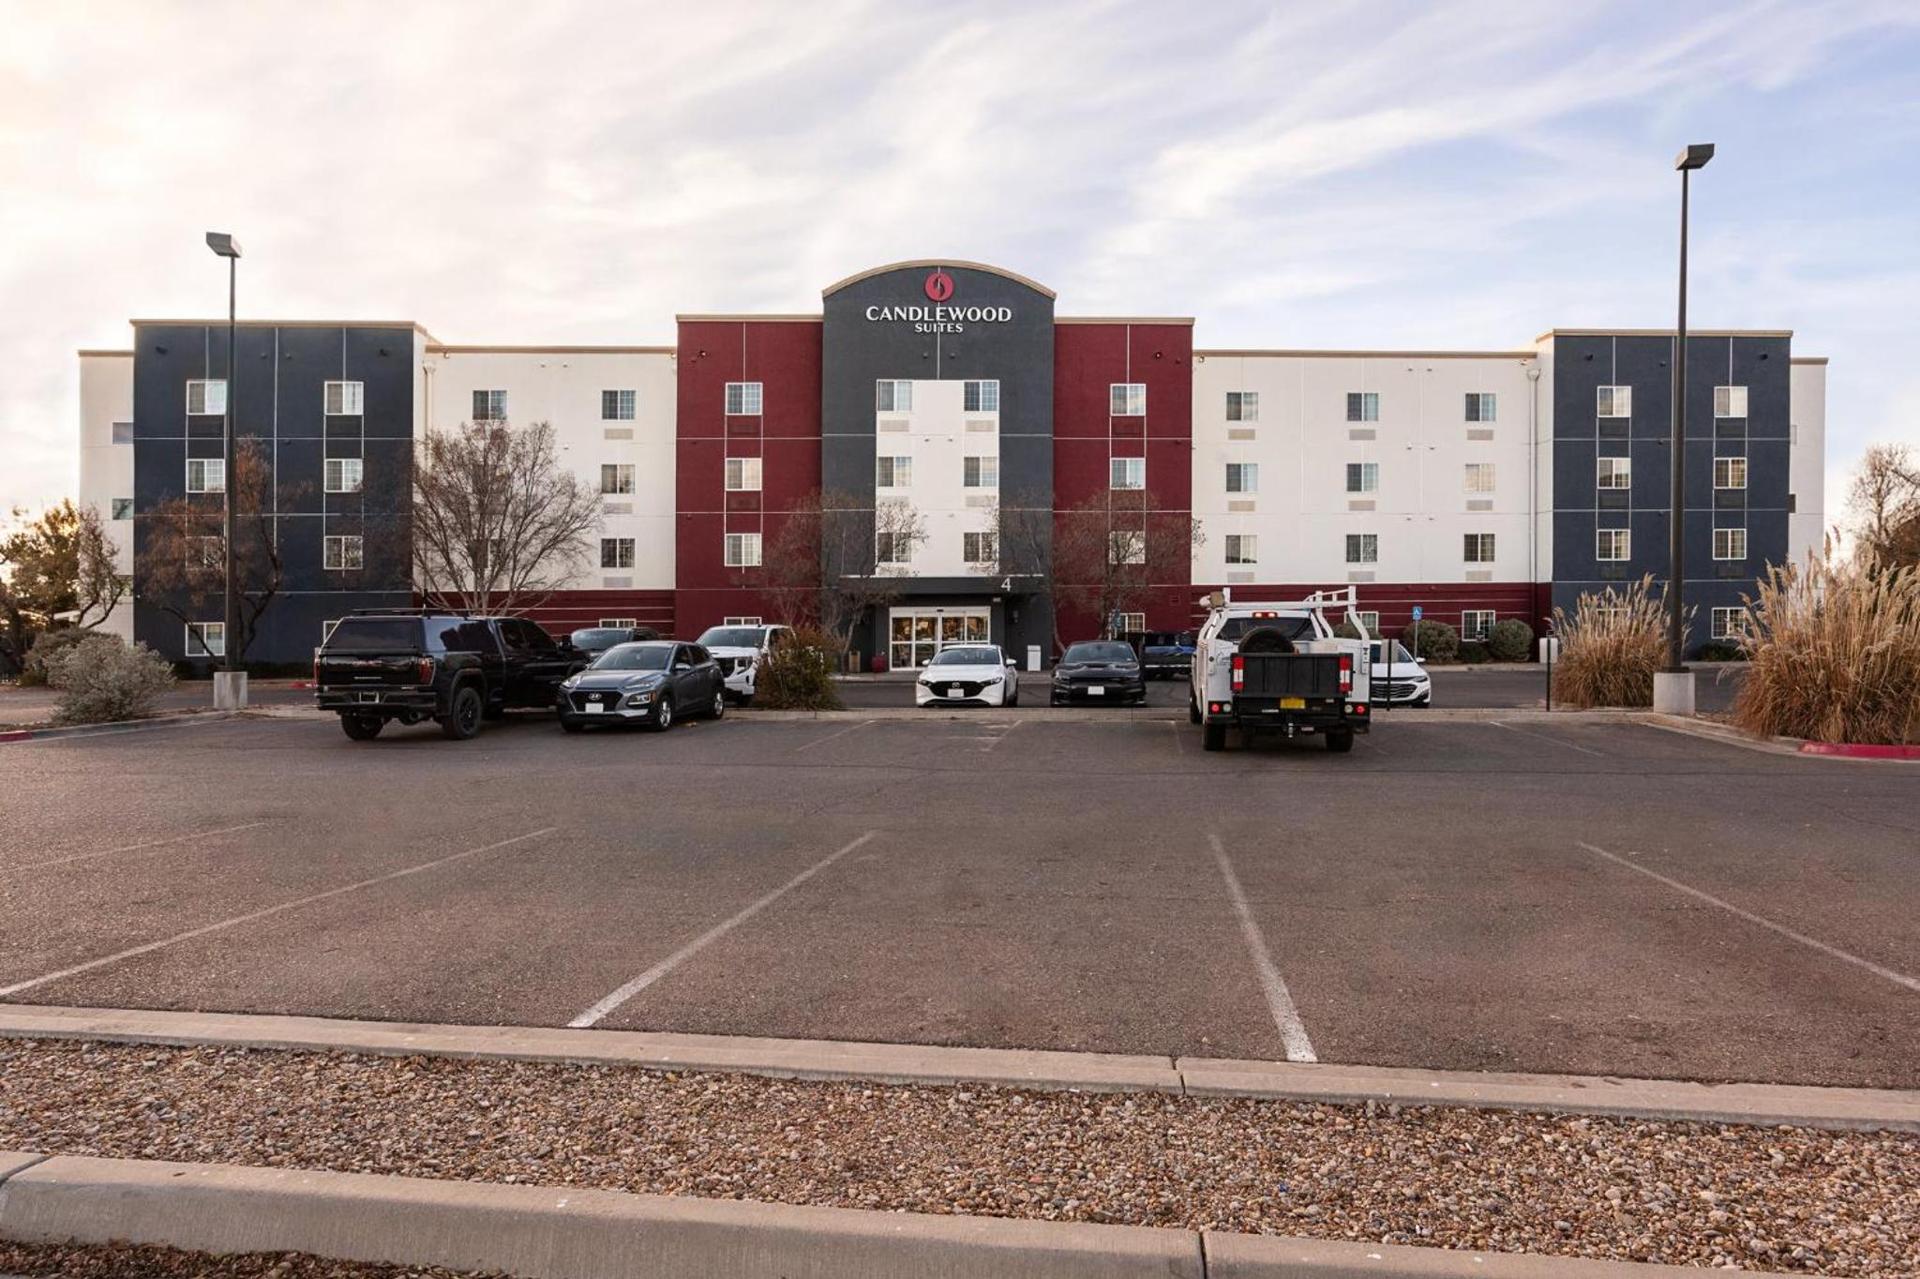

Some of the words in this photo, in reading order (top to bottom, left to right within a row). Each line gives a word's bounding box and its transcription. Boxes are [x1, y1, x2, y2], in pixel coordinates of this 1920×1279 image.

[865, 305, 1012, 322] CANDLEWOOD
[914, 322, 964, 333] SUITES
[1001, 577, 1011, 592] 4
